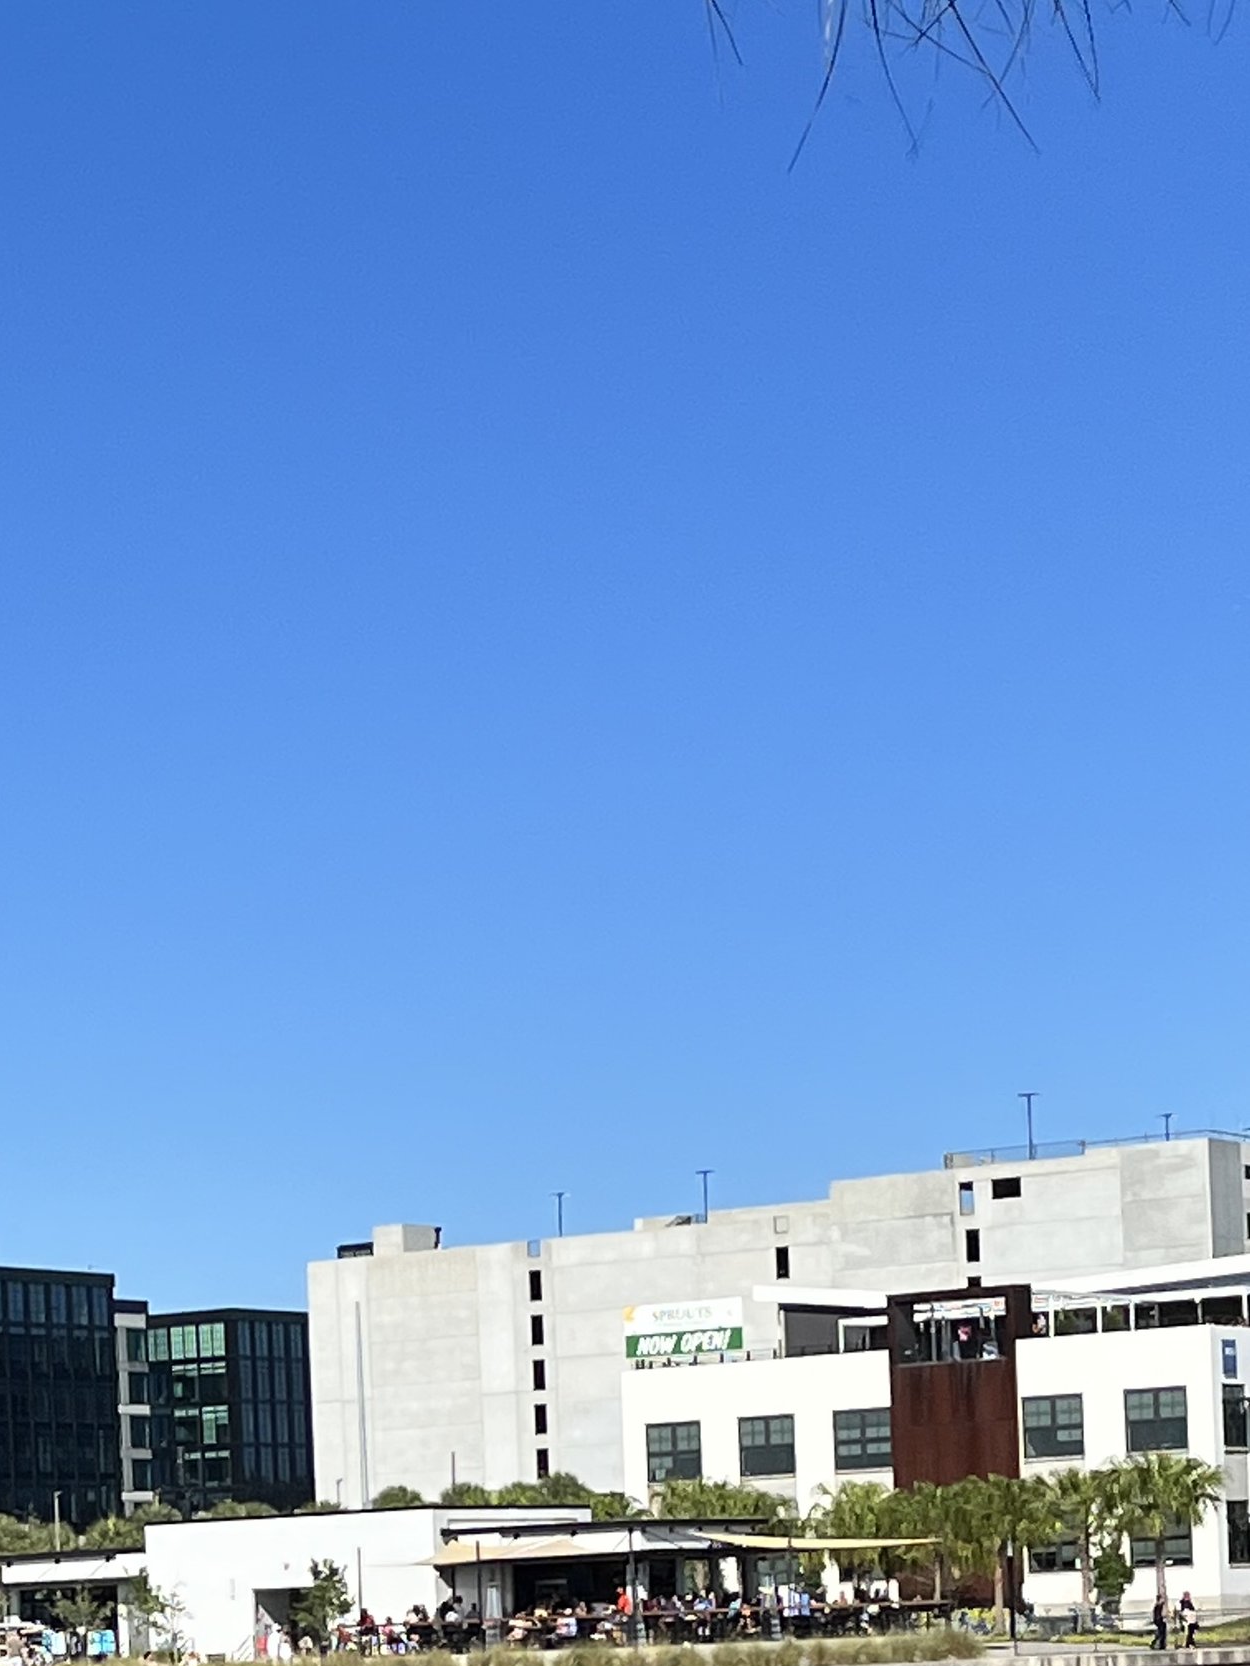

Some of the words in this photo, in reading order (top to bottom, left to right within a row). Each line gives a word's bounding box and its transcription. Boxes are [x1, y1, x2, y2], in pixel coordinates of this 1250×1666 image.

[652, 1306, 712, 1321] SPROUTS
[636, 1334, 678, 1356] NOW
[680, 1328, 731, 1353] OPEN!
